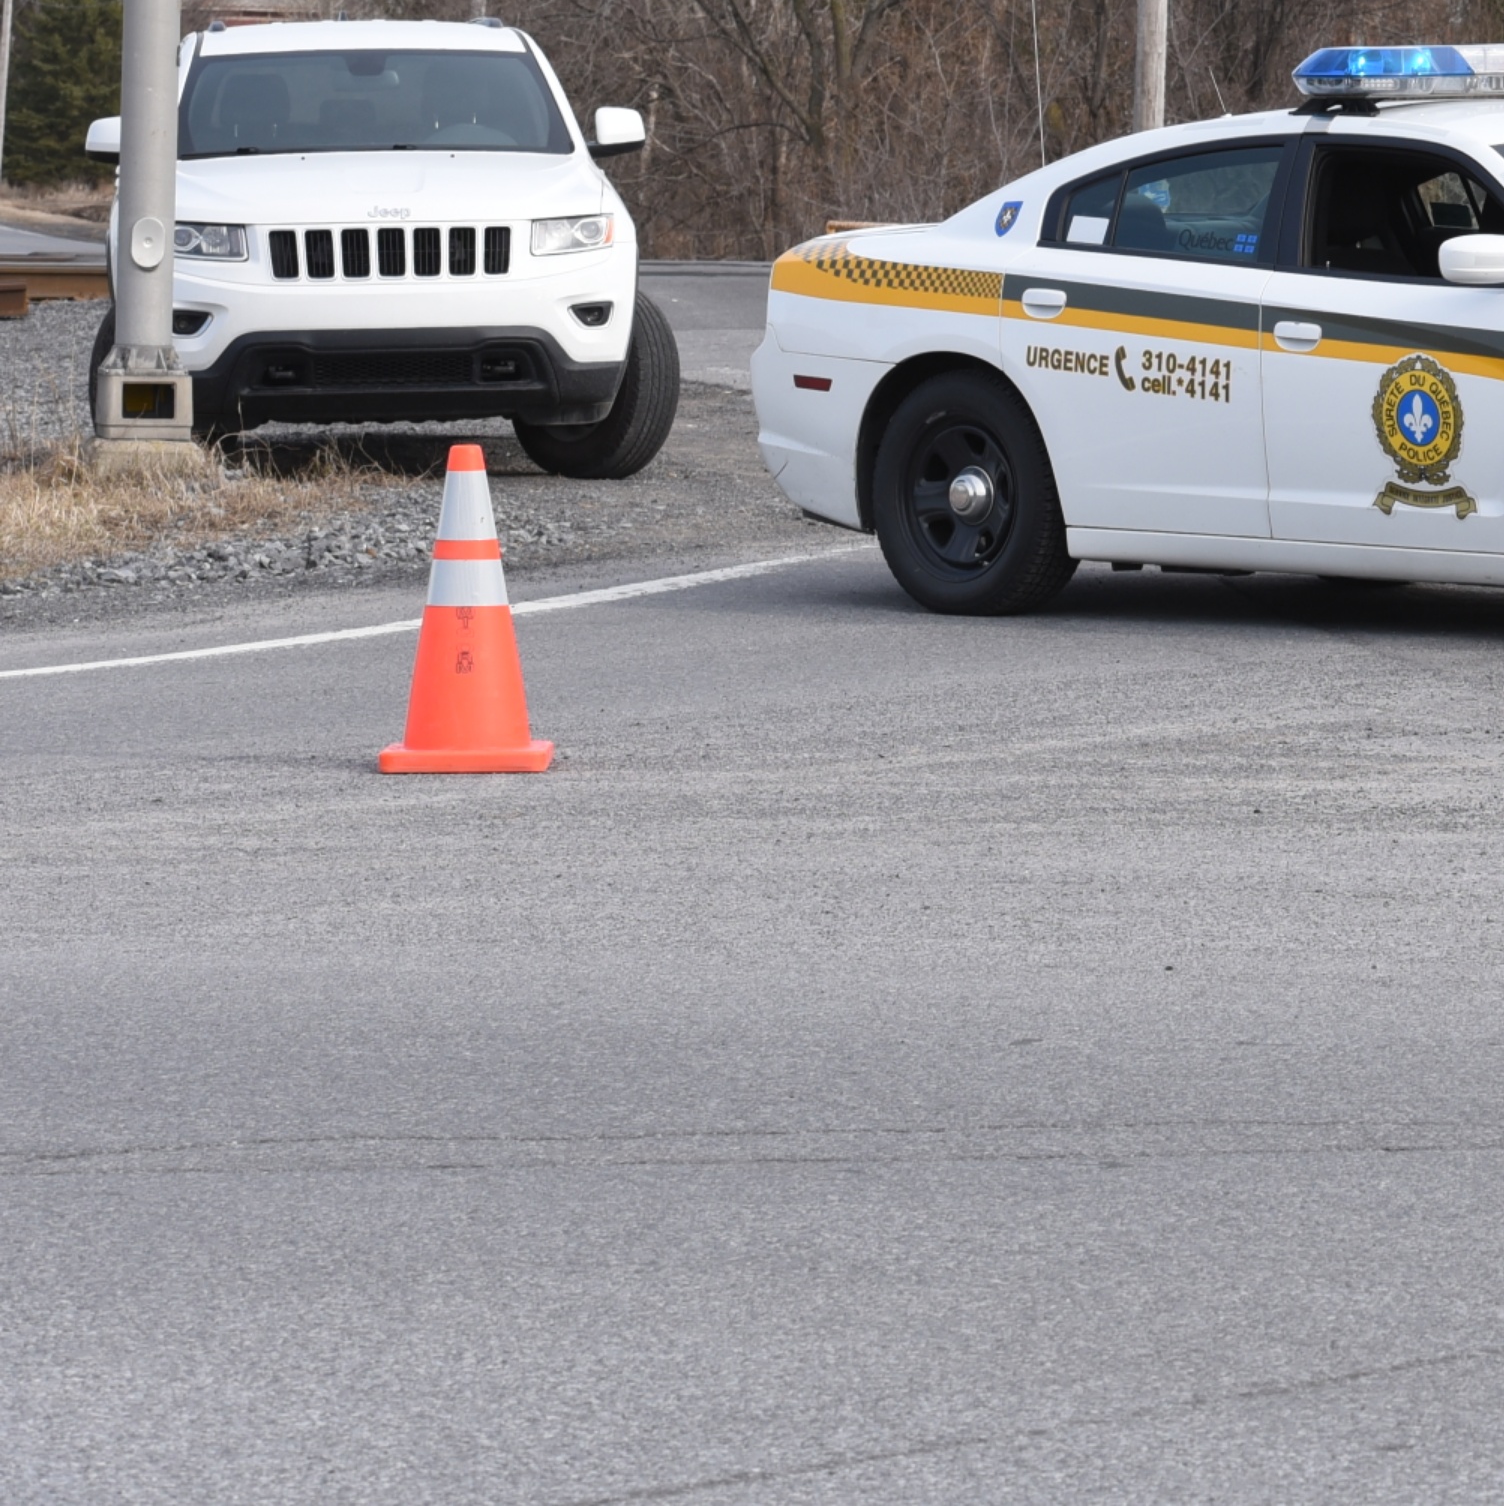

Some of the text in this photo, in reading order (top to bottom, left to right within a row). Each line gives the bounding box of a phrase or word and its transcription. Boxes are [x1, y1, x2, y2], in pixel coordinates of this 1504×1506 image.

[367, 205, 411, 220] Jeep
[1179, 228, 1234, 252] Québec
[1026, 345, 1109, 376] URGENCE
[1141, 349, 1231, 382] 310-4141
[1409, 373, 1426, 387] DU
[1398, 443, 1443, 463] POLICE
